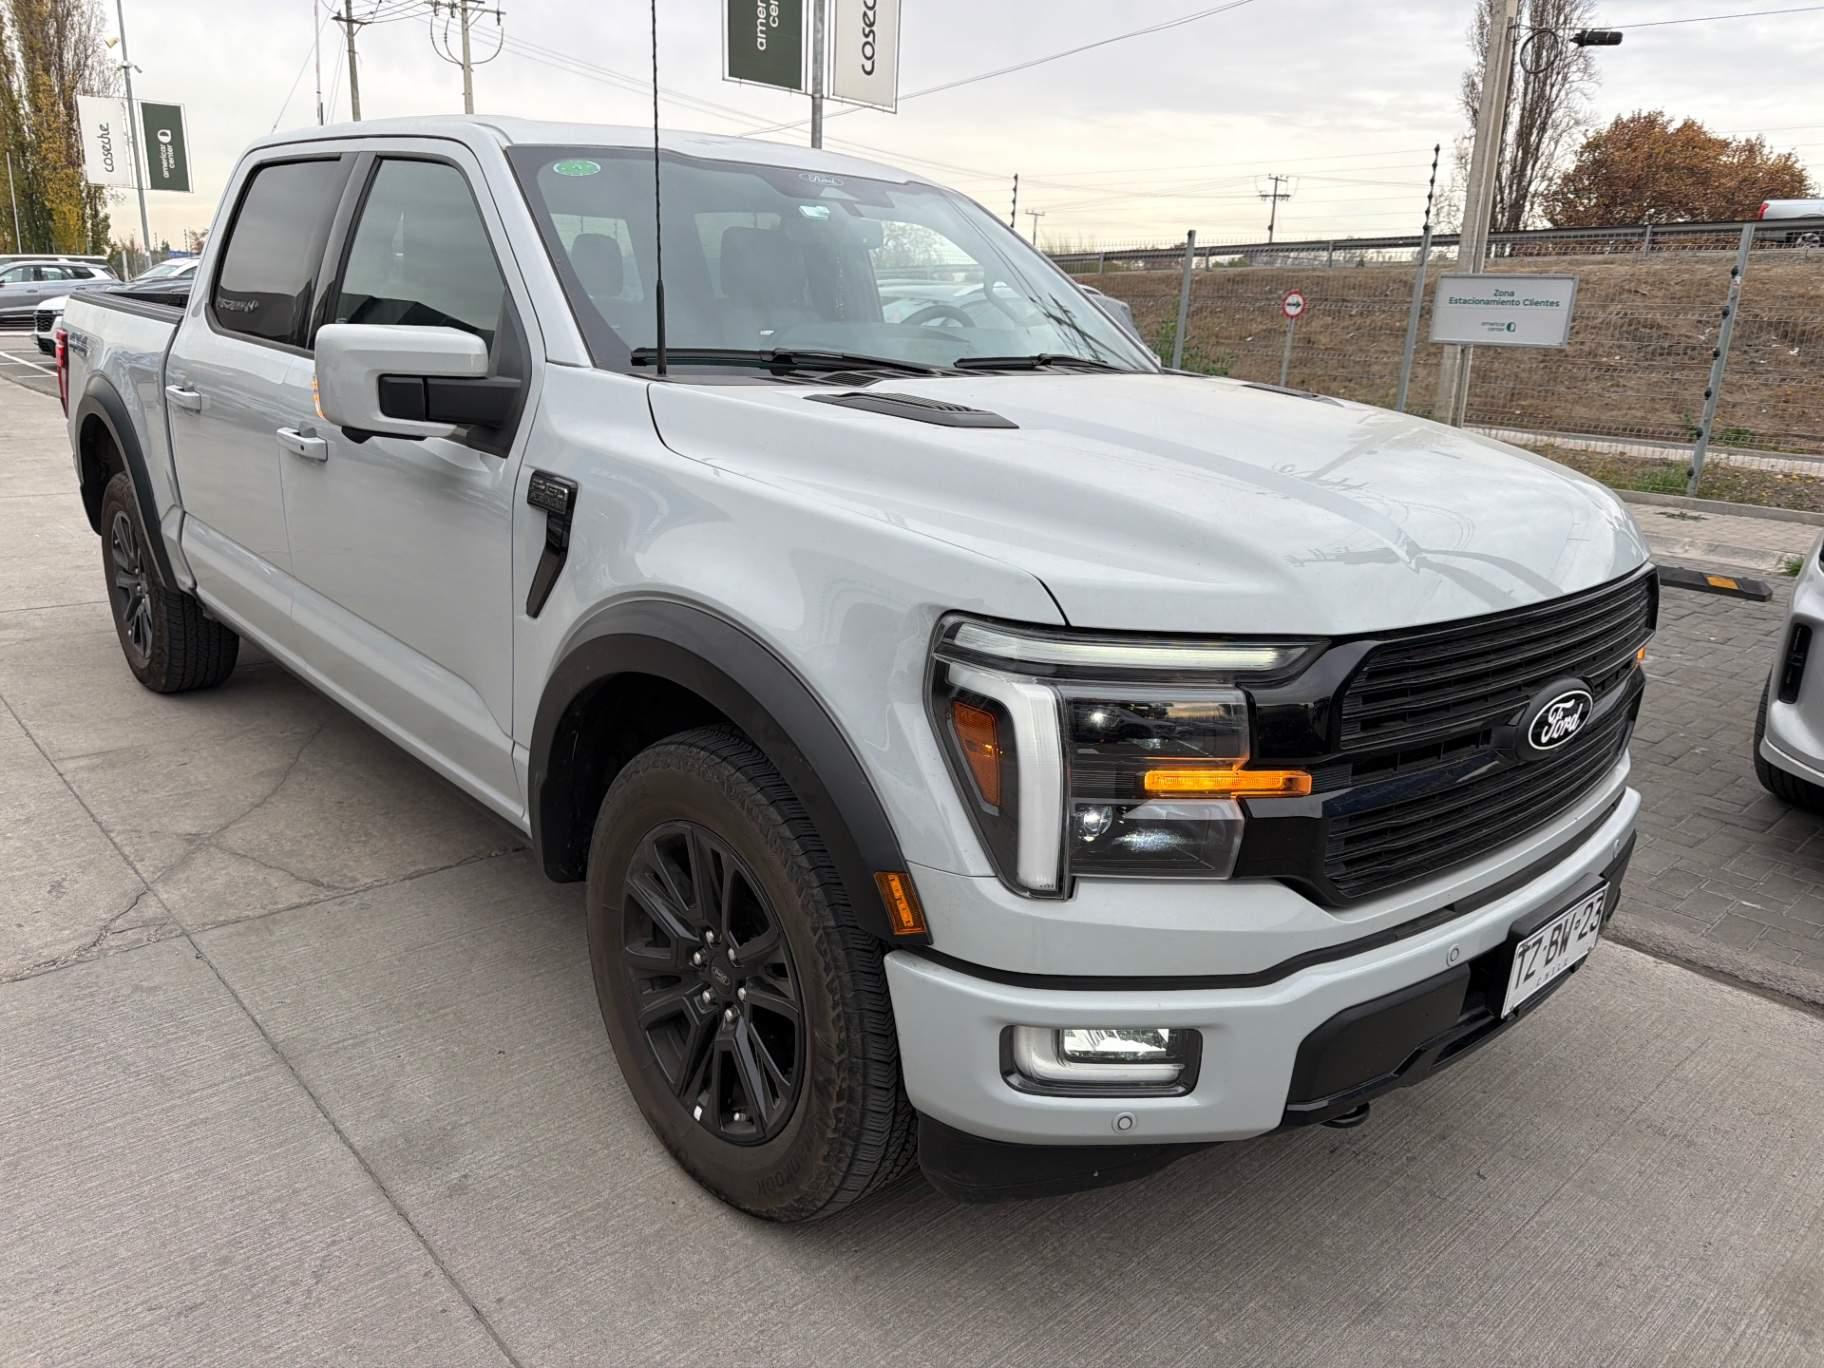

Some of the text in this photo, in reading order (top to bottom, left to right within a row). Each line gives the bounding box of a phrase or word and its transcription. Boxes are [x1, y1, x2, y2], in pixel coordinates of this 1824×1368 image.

[97, 122, 114, 173] coseche
[160, 144, 170, 178] americar
[167, 145, 175, 168] center
[1448, 297, 1560, 307] Estacionamiento Clientes
[1493, 289, 1515, 297] Zona
[1541, 699, 1583, 743] Ford
